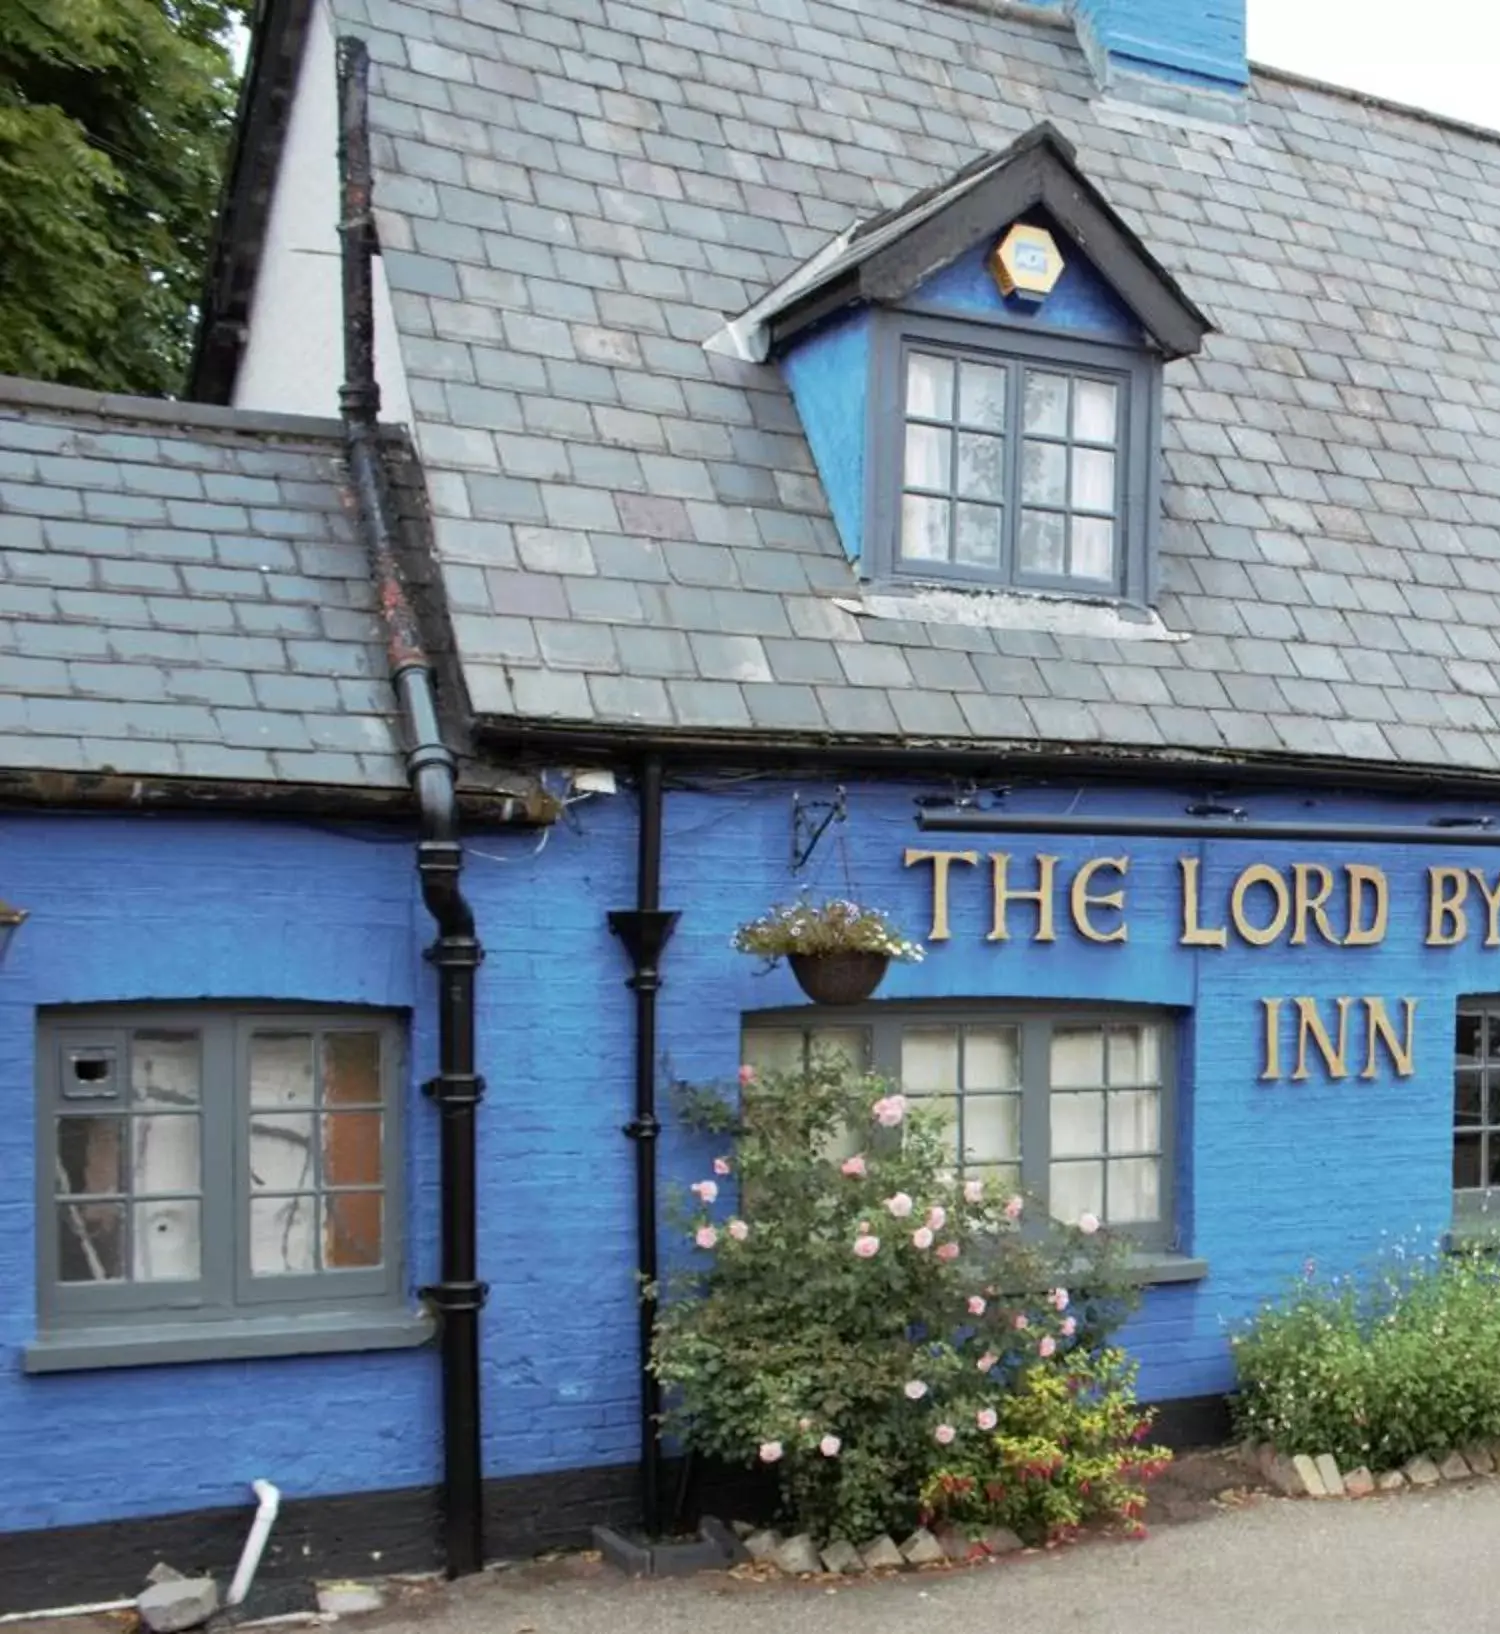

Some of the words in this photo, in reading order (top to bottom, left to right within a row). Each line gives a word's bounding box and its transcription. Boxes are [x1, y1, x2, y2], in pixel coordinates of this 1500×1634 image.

[904, 848, 1130, 943] THE
[1178, 857, 1390, 949] LORD
[1260, 996, 1418, 1081] INN
